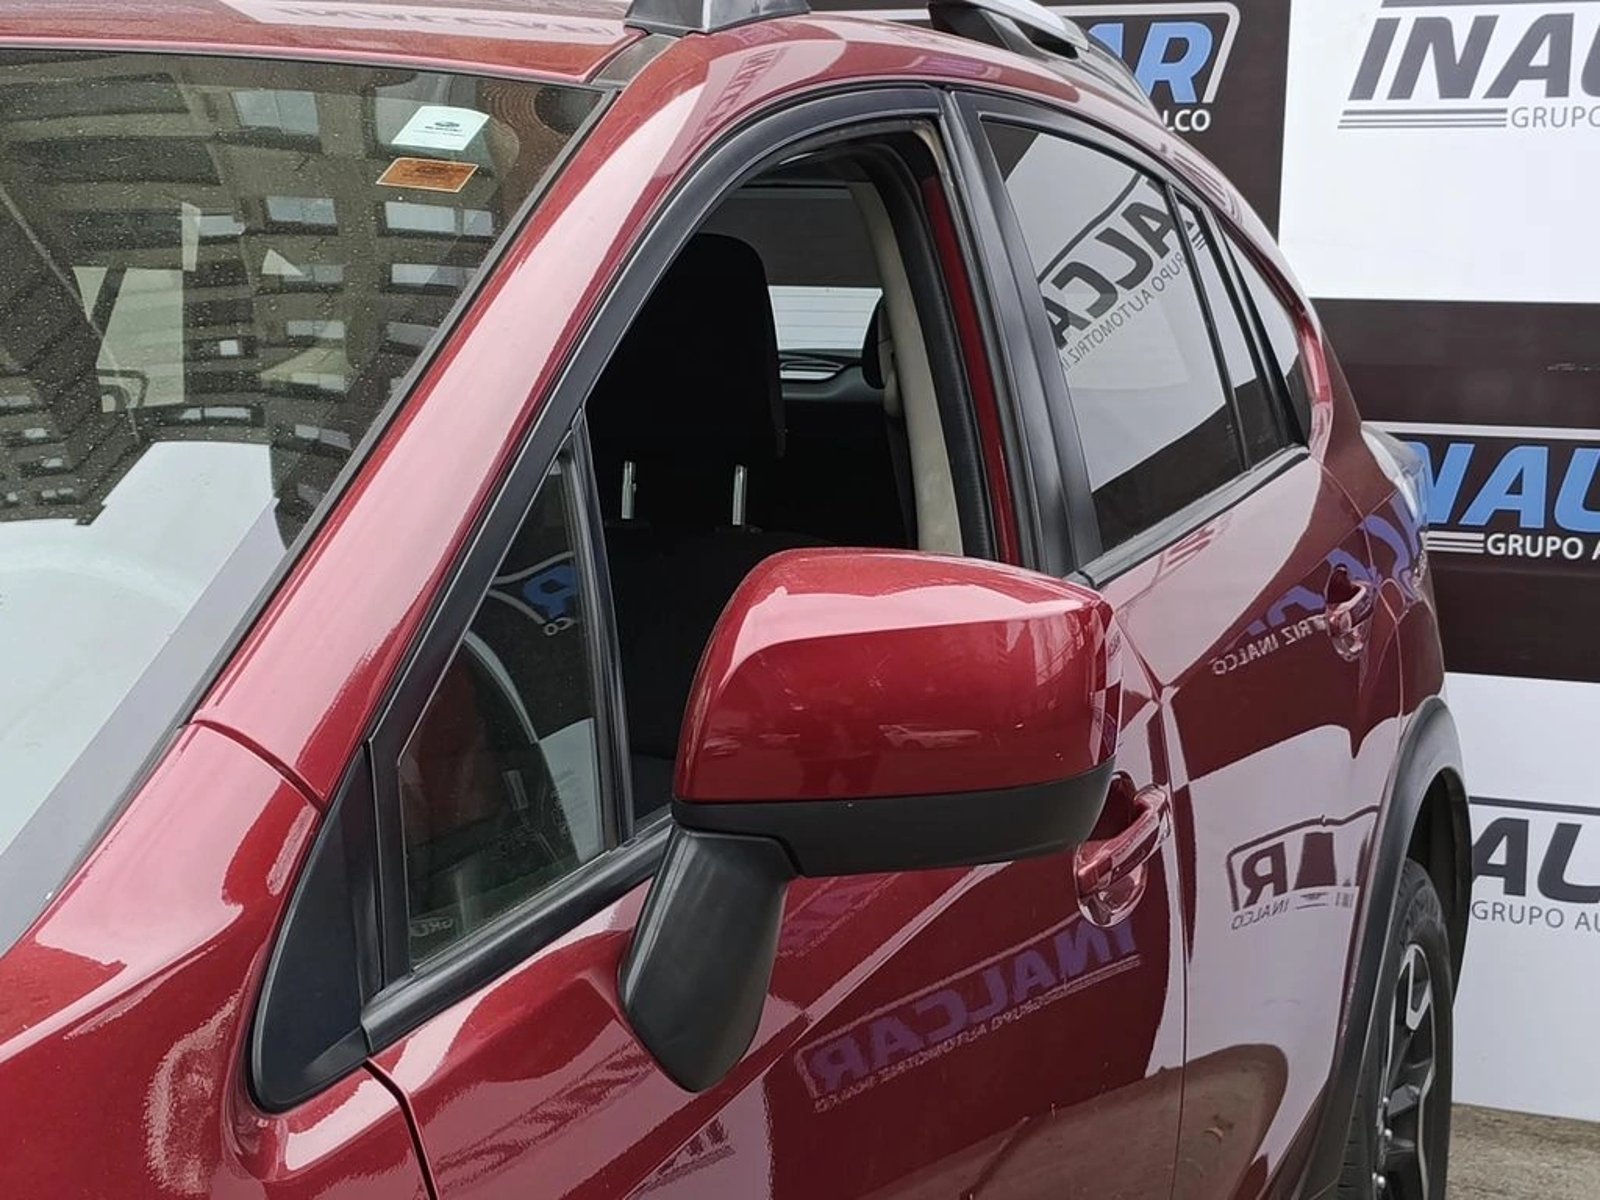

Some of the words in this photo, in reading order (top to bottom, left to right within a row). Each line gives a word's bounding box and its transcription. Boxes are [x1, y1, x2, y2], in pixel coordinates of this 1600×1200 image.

[1348, 12, 1600, 100] INA
[1487, 533, 1584, 560] GRUPO
[1472, 900, 1564, 928] GRUPO
